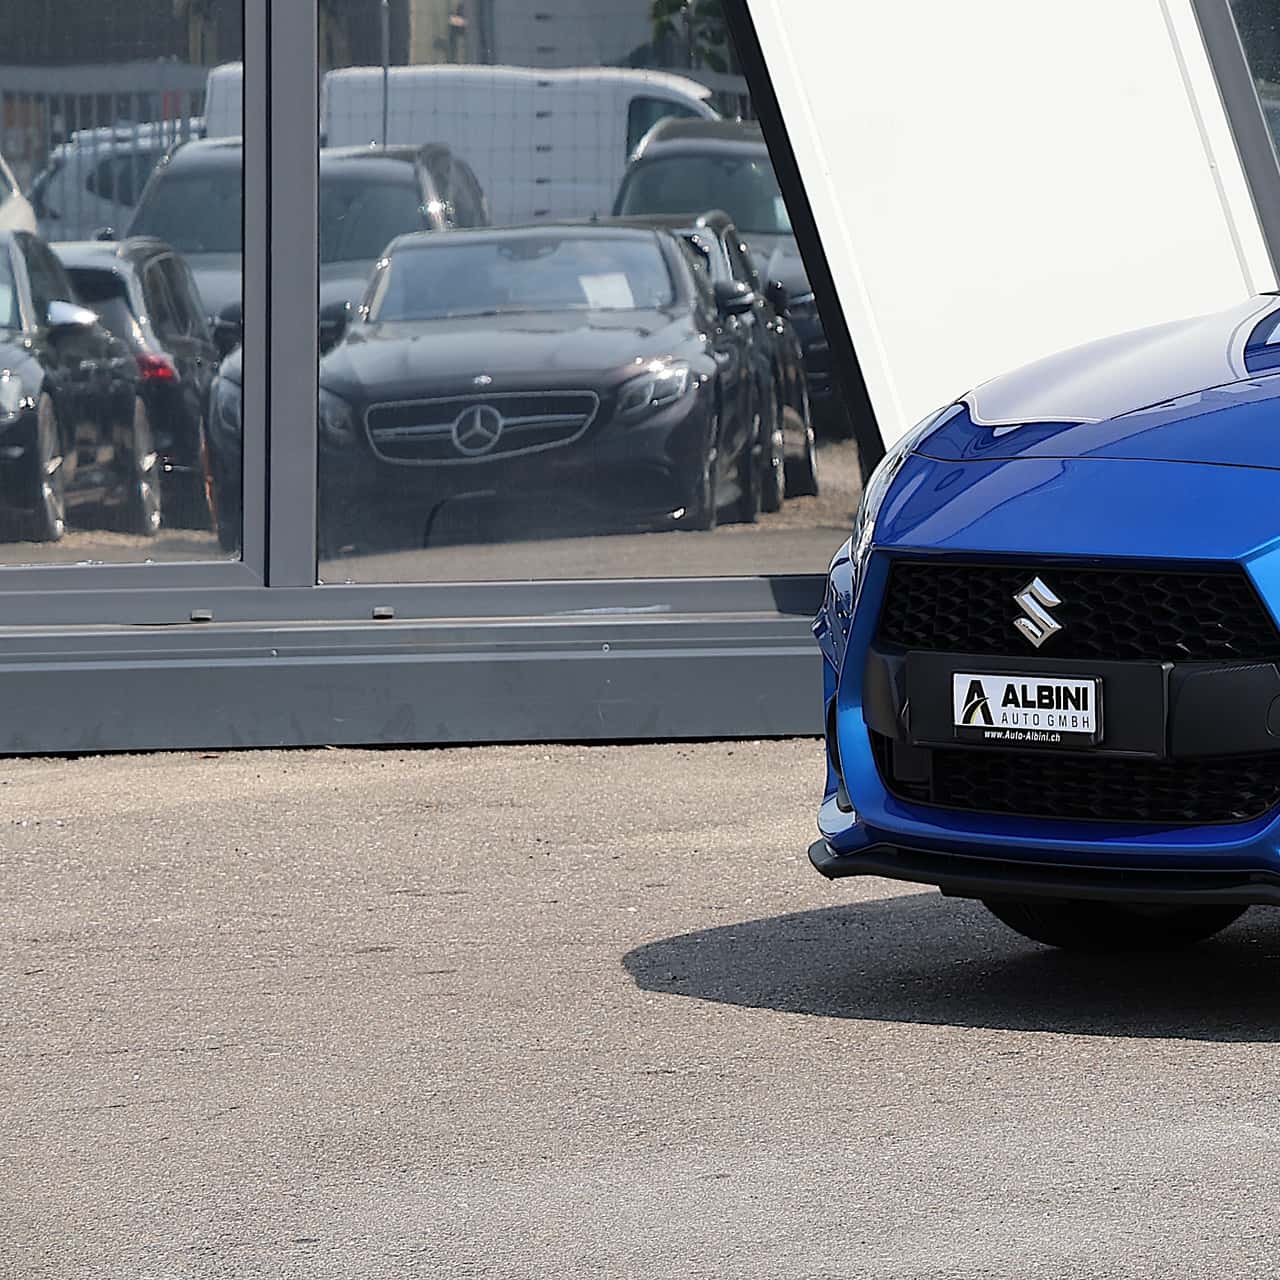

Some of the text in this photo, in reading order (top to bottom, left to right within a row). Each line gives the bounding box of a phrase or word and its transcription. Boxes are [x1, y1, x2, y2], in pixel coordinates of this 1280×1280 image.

[1001, 683, 1089, 711] ALBINI
[1001, 713, 1090, 729] AUTO GMBH
